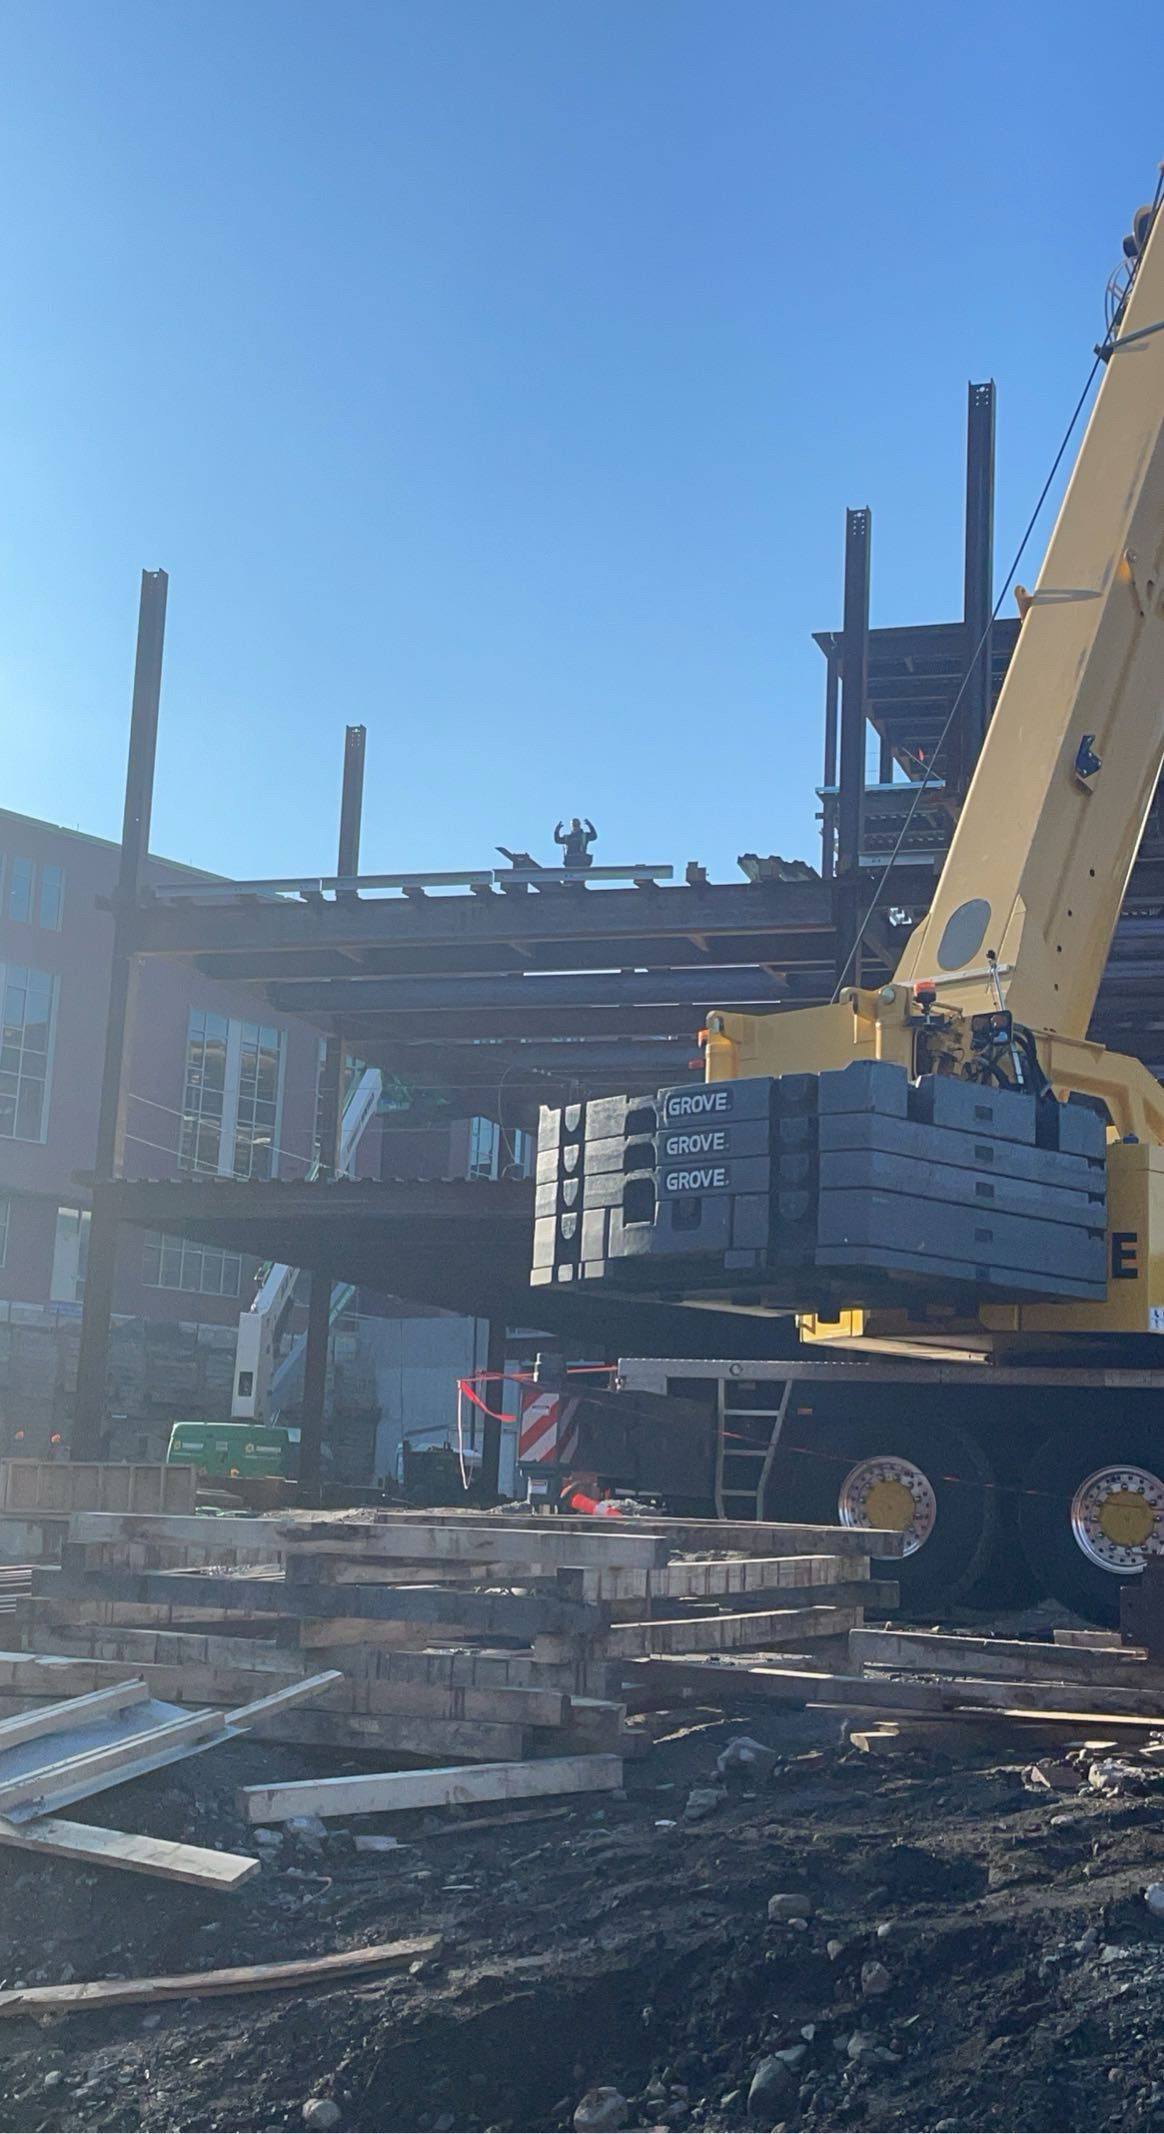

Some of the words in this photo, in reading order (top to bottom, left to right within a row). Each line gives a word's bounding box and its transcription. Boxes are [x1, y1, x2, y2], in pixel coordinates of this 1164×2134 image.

[668, 1092, 728, 1116] GROVE
[666, 1132, 725, 1155] GROVE
[666, 1168, 726, 1191] GROVE
